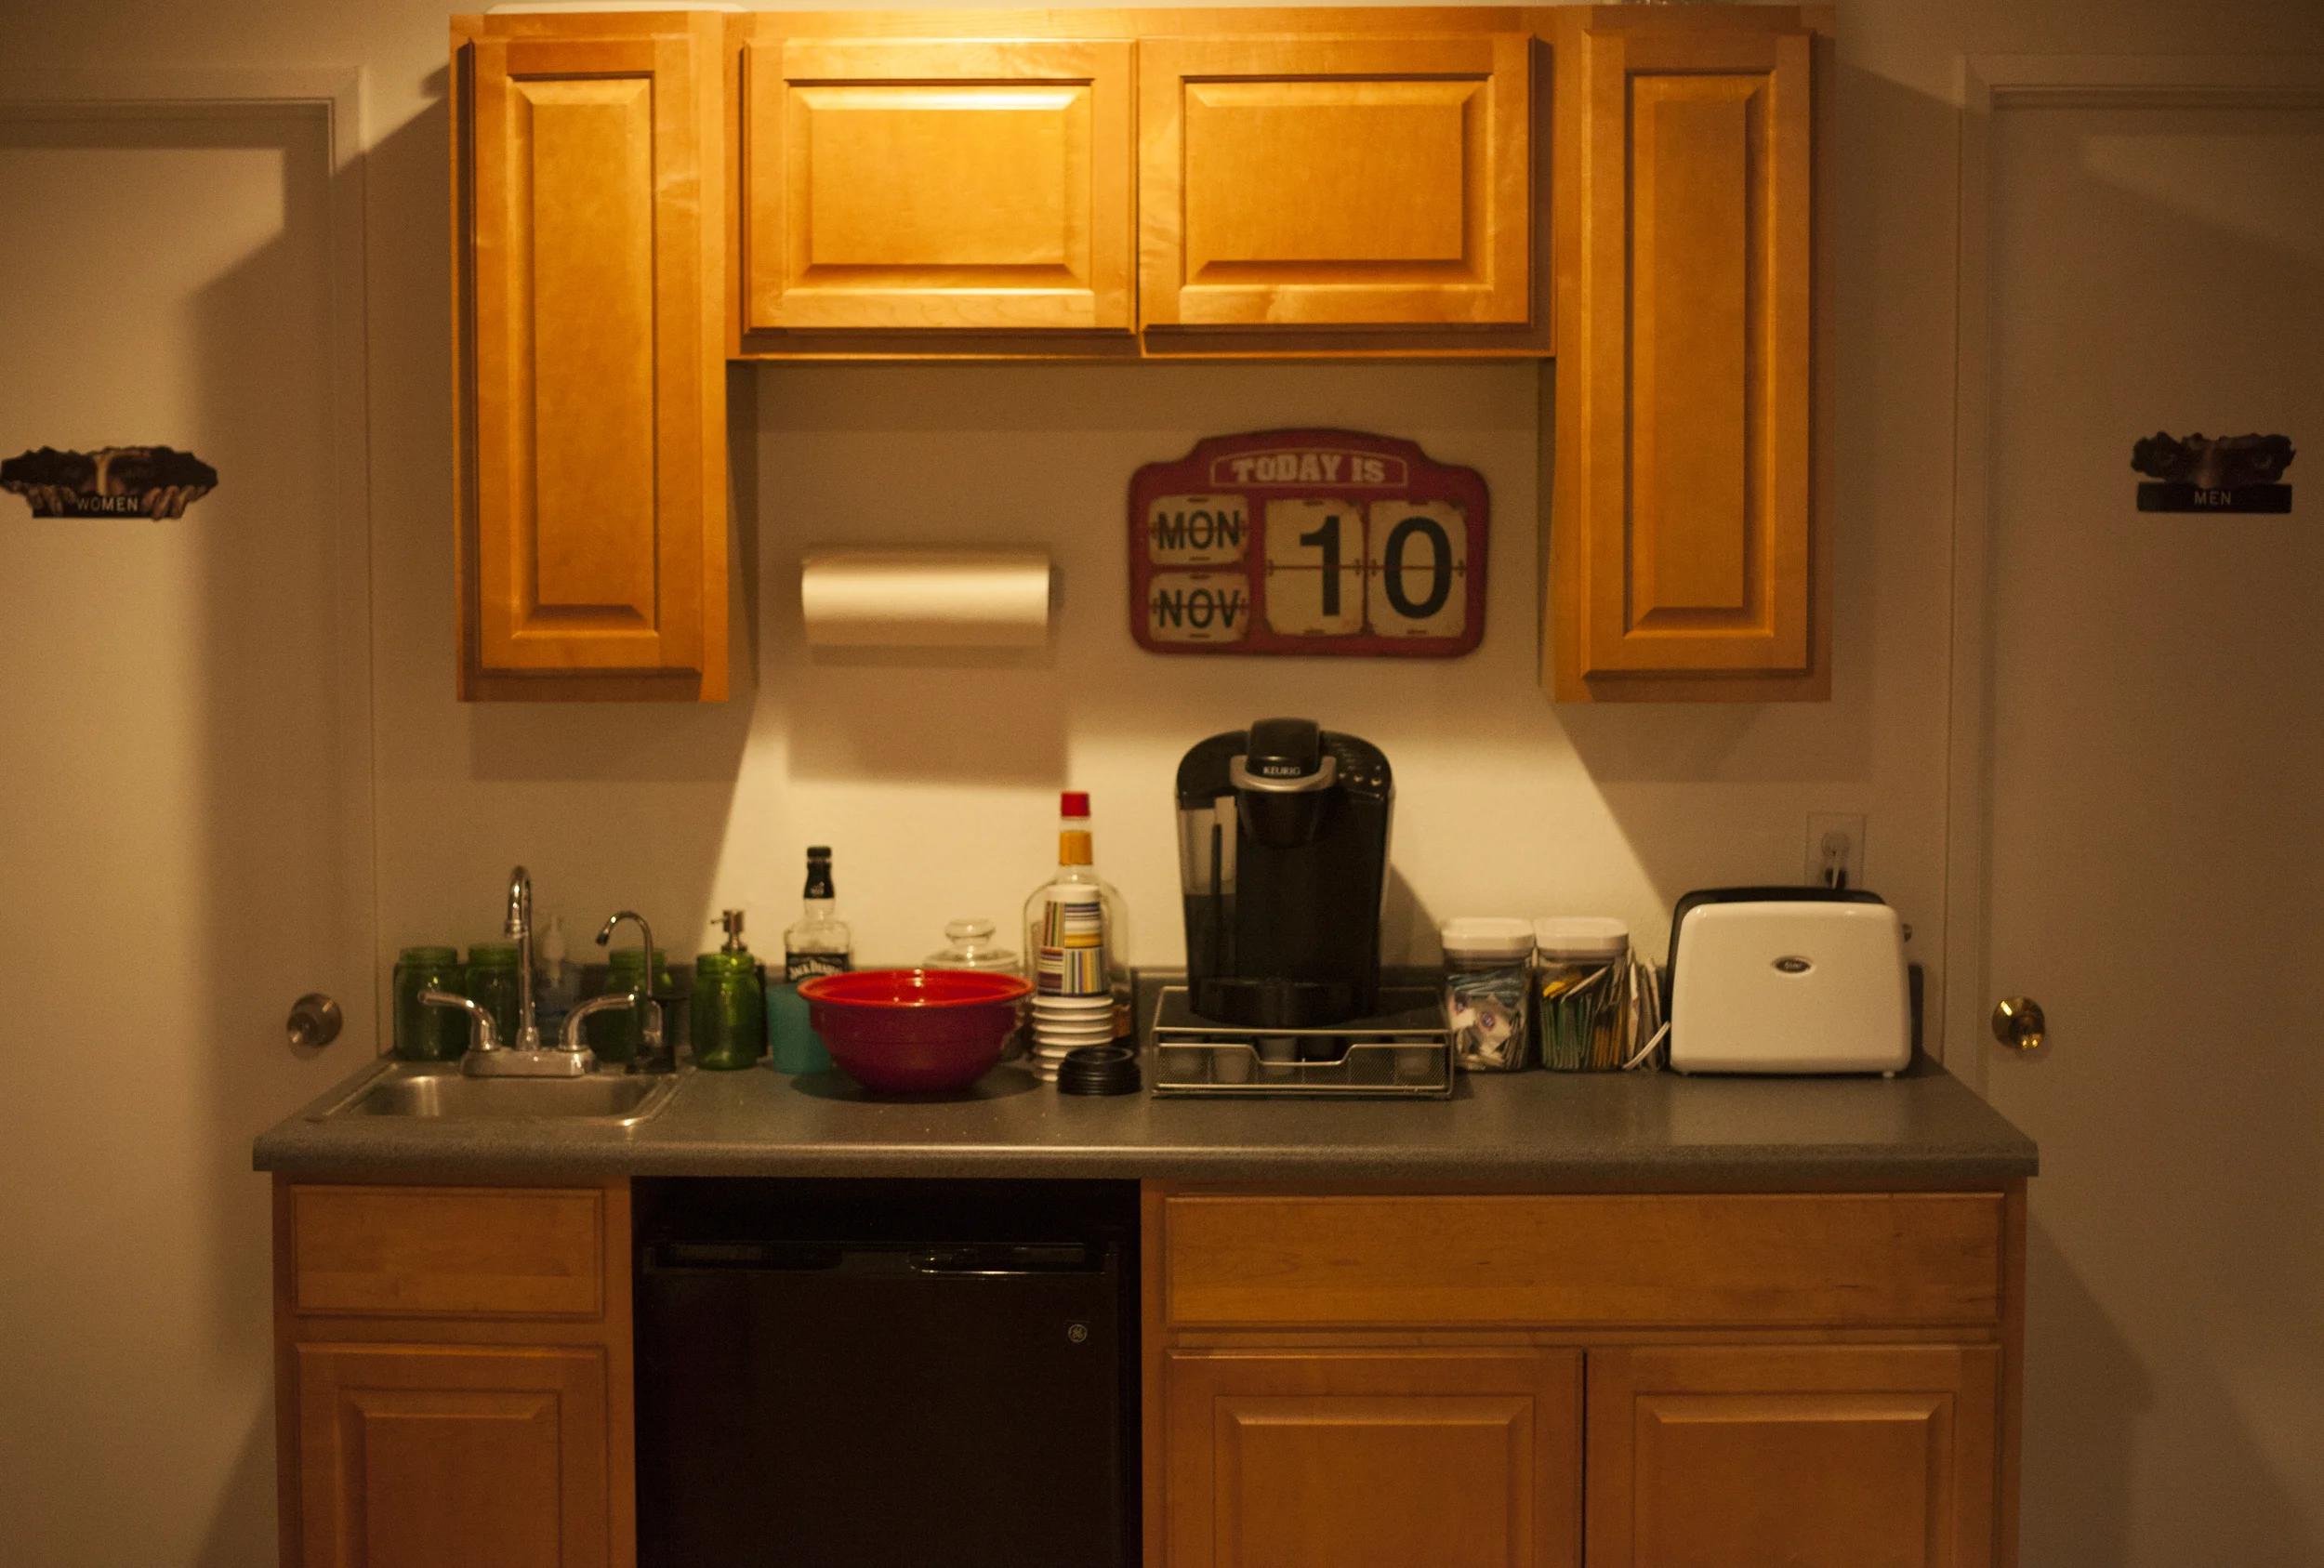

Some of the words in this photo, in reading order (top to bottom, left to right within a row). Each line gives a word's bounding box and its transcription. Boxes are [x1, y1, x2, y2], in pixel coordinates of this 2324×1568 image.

[1234, 453, 1340, 482] TODAY
[1352, 457, 1385, 482] IS
[78, 497, 139, 511] WOMEN
[2195, 491, 2231, 506] MEN
[1157, 510, 1240, 551] MON
[1159, 589, 1240, 628] NOV
[1262, 766, 1301, 776] KEURIG
